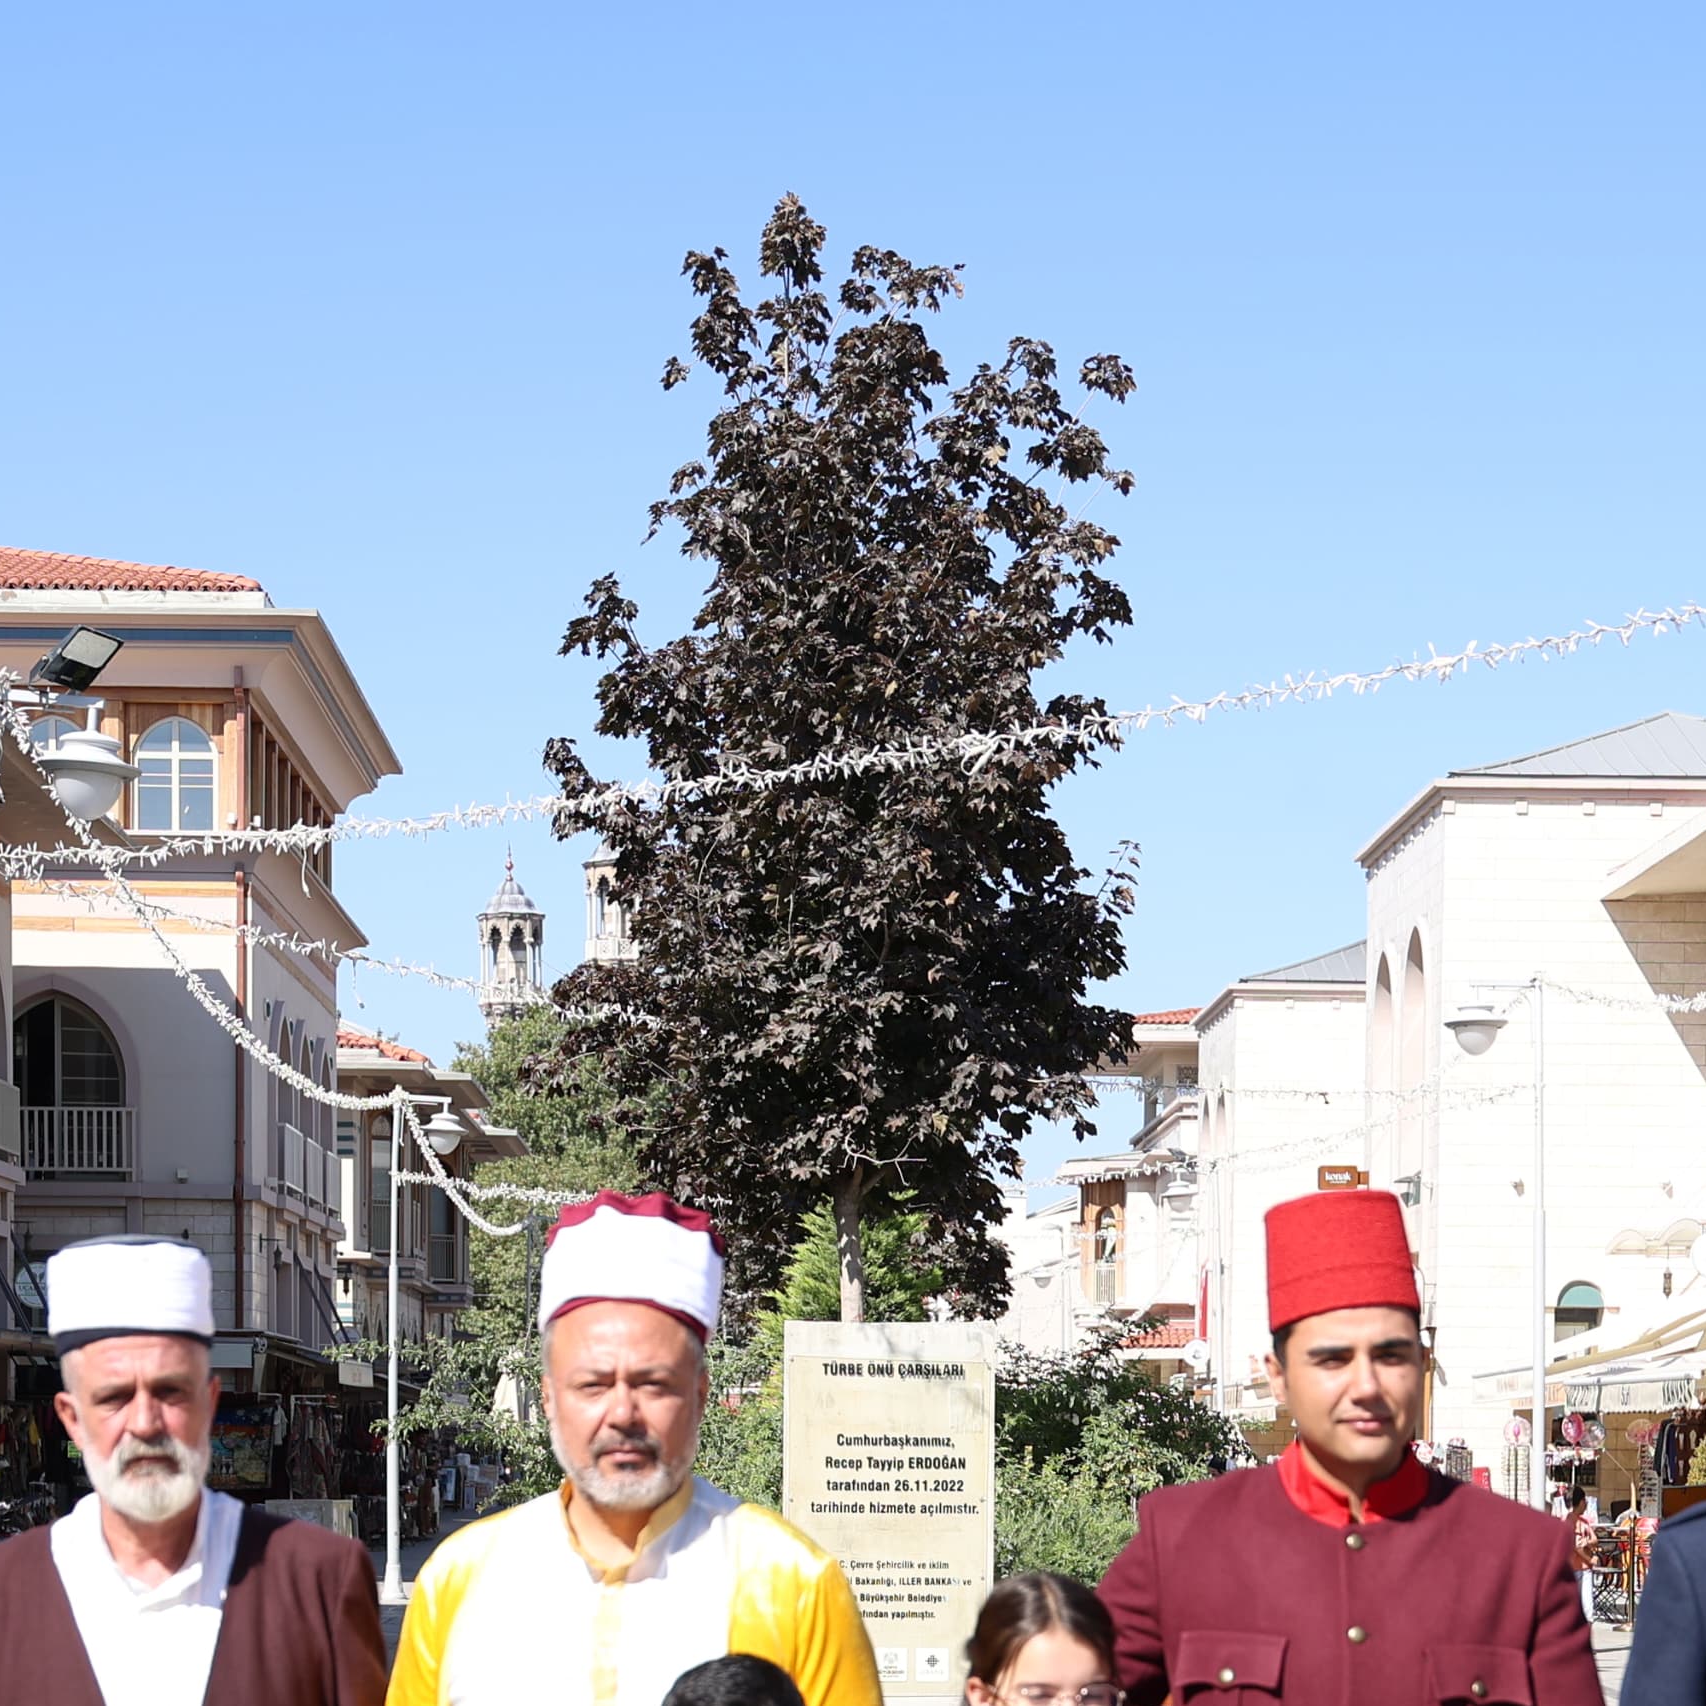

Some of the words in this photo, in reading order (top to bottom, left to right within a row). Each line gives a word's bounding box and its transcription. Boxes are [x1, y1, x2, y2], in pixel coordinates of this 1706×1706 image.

[822, 1361, 863, 1376] TÜRBE
[867, 1361, 894, 1377] ÖNÜ
[898, 1363, 965, 1381] ÇARŞILARI
[837, 1434, 955, 1449] Cumhurbaşkanımız,
[825, 1457, 862, 1471] Recep
[867, 1456, 904, 1471] Tayyip
[908, 1455, 966, 1470] ERDOĞAN
[827, 1480, 890, 1491] tarafından
[894, 1480, 964, 1491] 26.11.2022
[811, 1501, 865, 1514] tarihinde
[870, 1501, 916, 1514] hizmete
[850, 1559, 874, 1570] Çevre
[876, 1560, 914, 1570] Şehircilik
[860, 1594, 905, 1603] Büyükşehir
[907, 1594, 946, 1603] Belediye
[860, 1610, 889, 1619] fından
